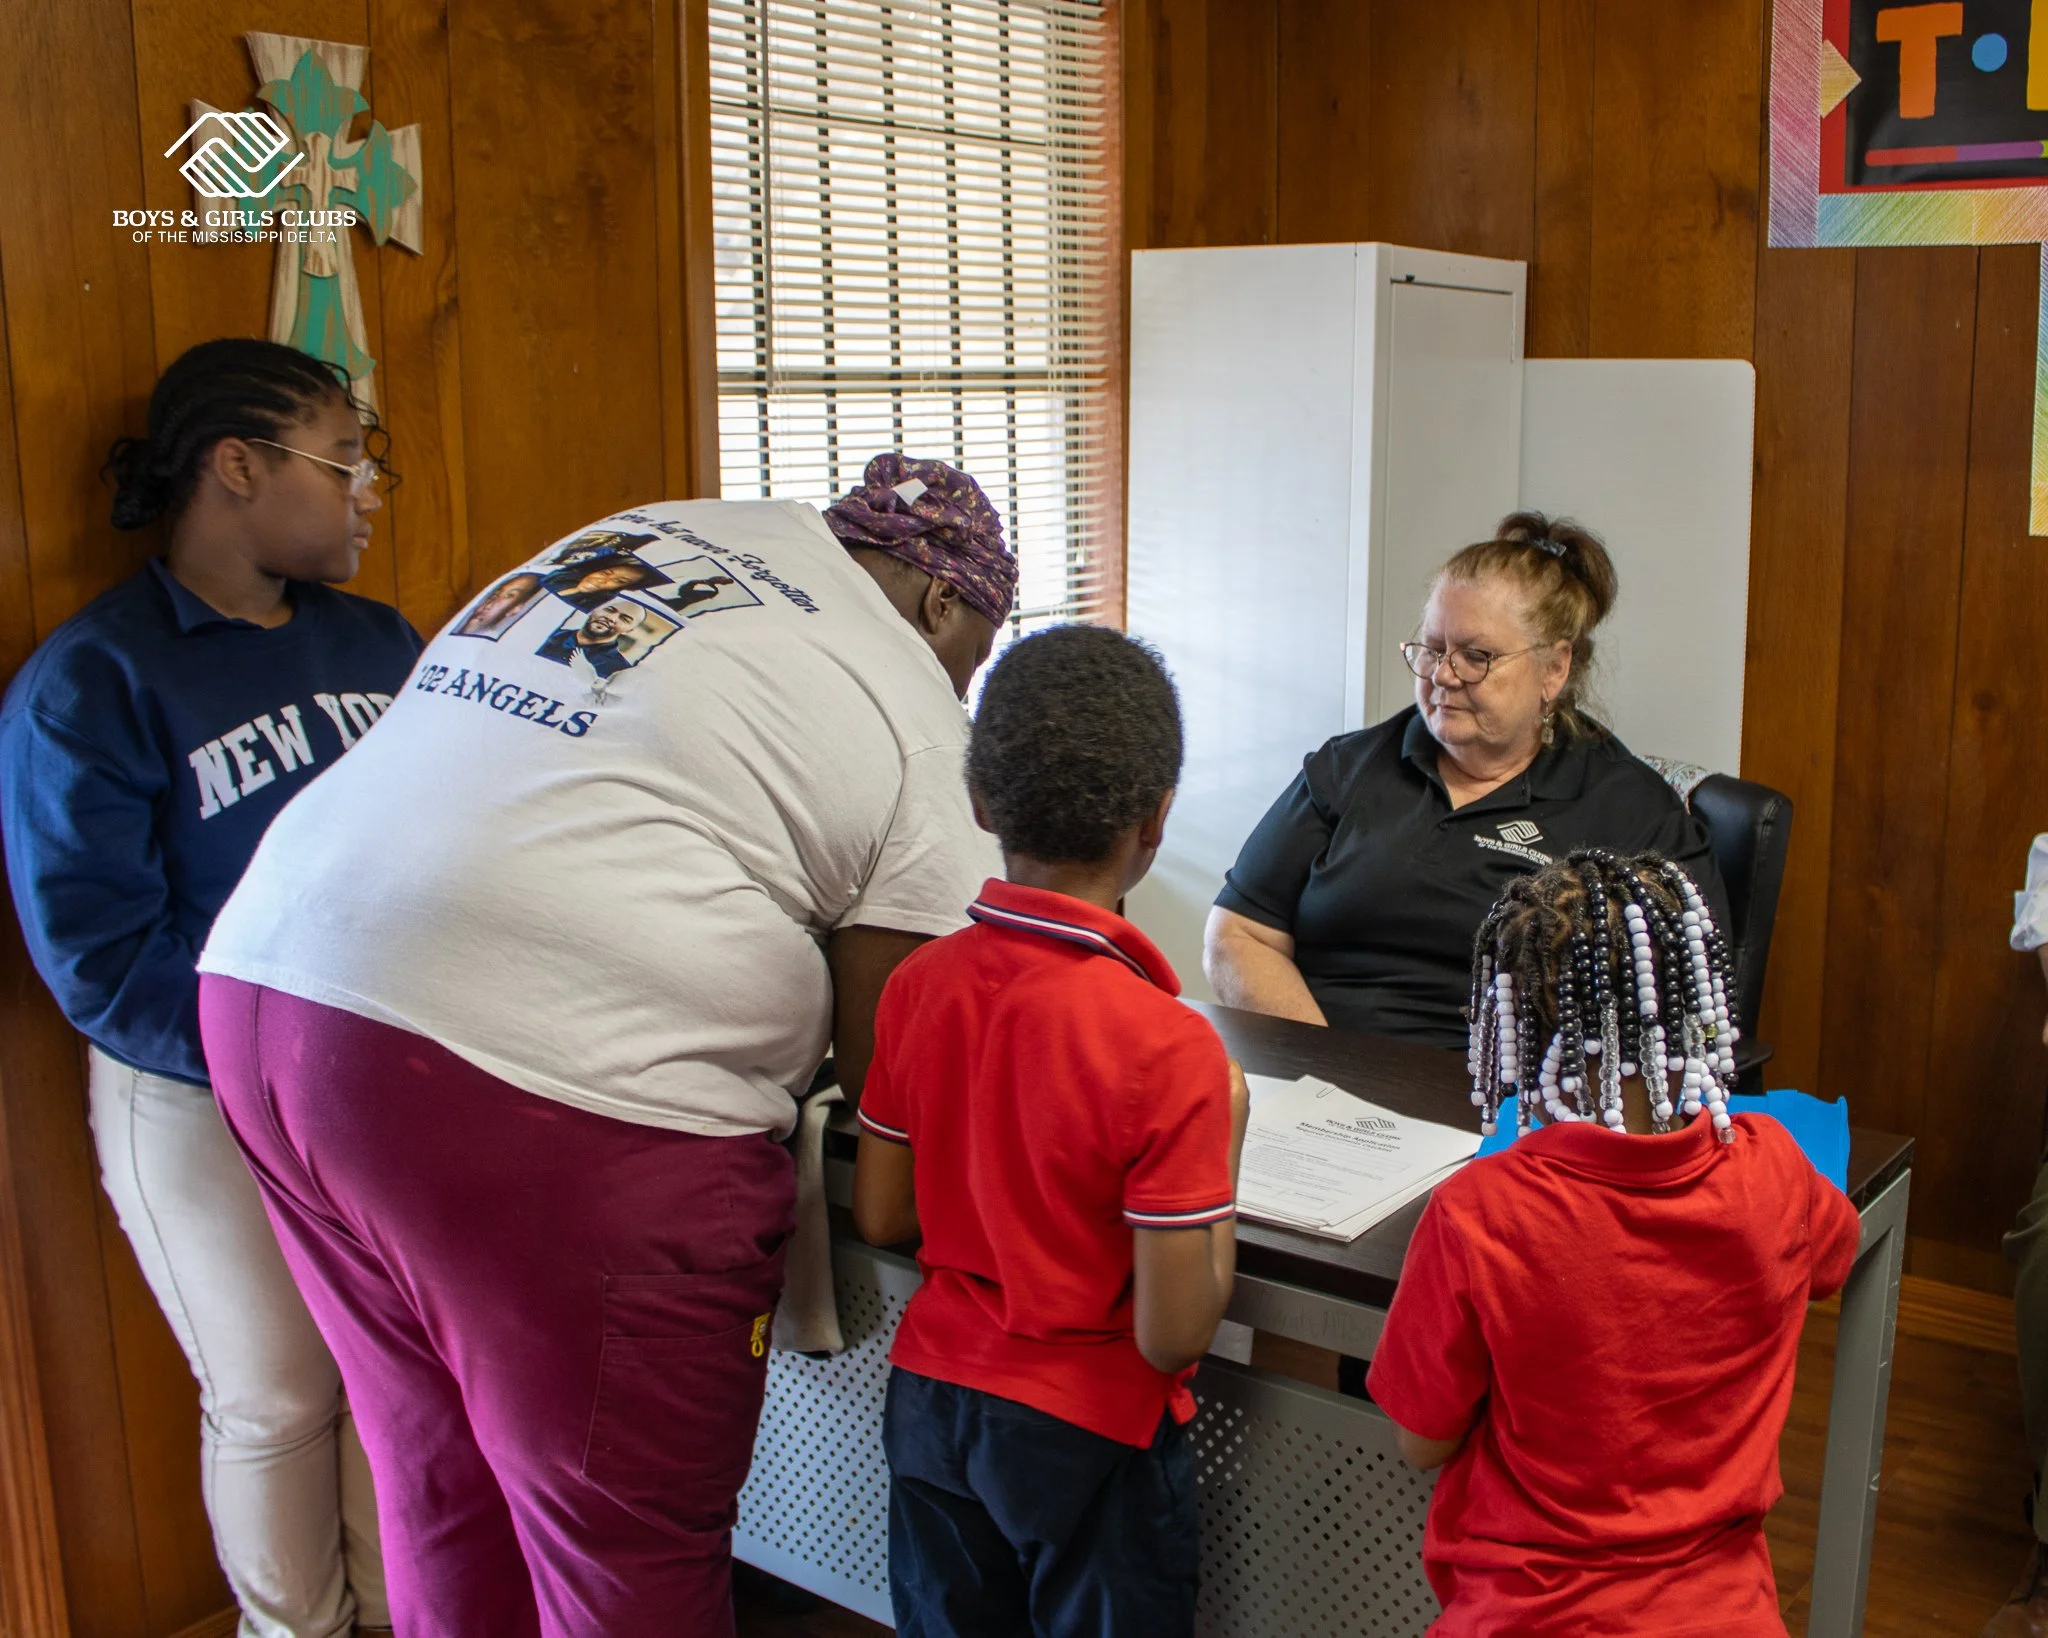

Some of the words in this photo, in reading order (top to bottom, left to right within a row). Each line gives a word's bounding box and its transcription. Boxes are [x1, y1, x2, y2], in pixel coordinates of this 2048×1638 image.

[726, 553, 821, 613] Forgotten
[441, 668, 599, 738] ANGELS
[188, 704, 315, 821] NEW
[1473, 834, 1496, 846] BOYS
[1495, 840, 1503, 848] &
[1504, 842, 1528, 854] GIRLS
[1299, 1121, 1352, 1139] Membership
[1353, 1136, 1401, 1150] Application
